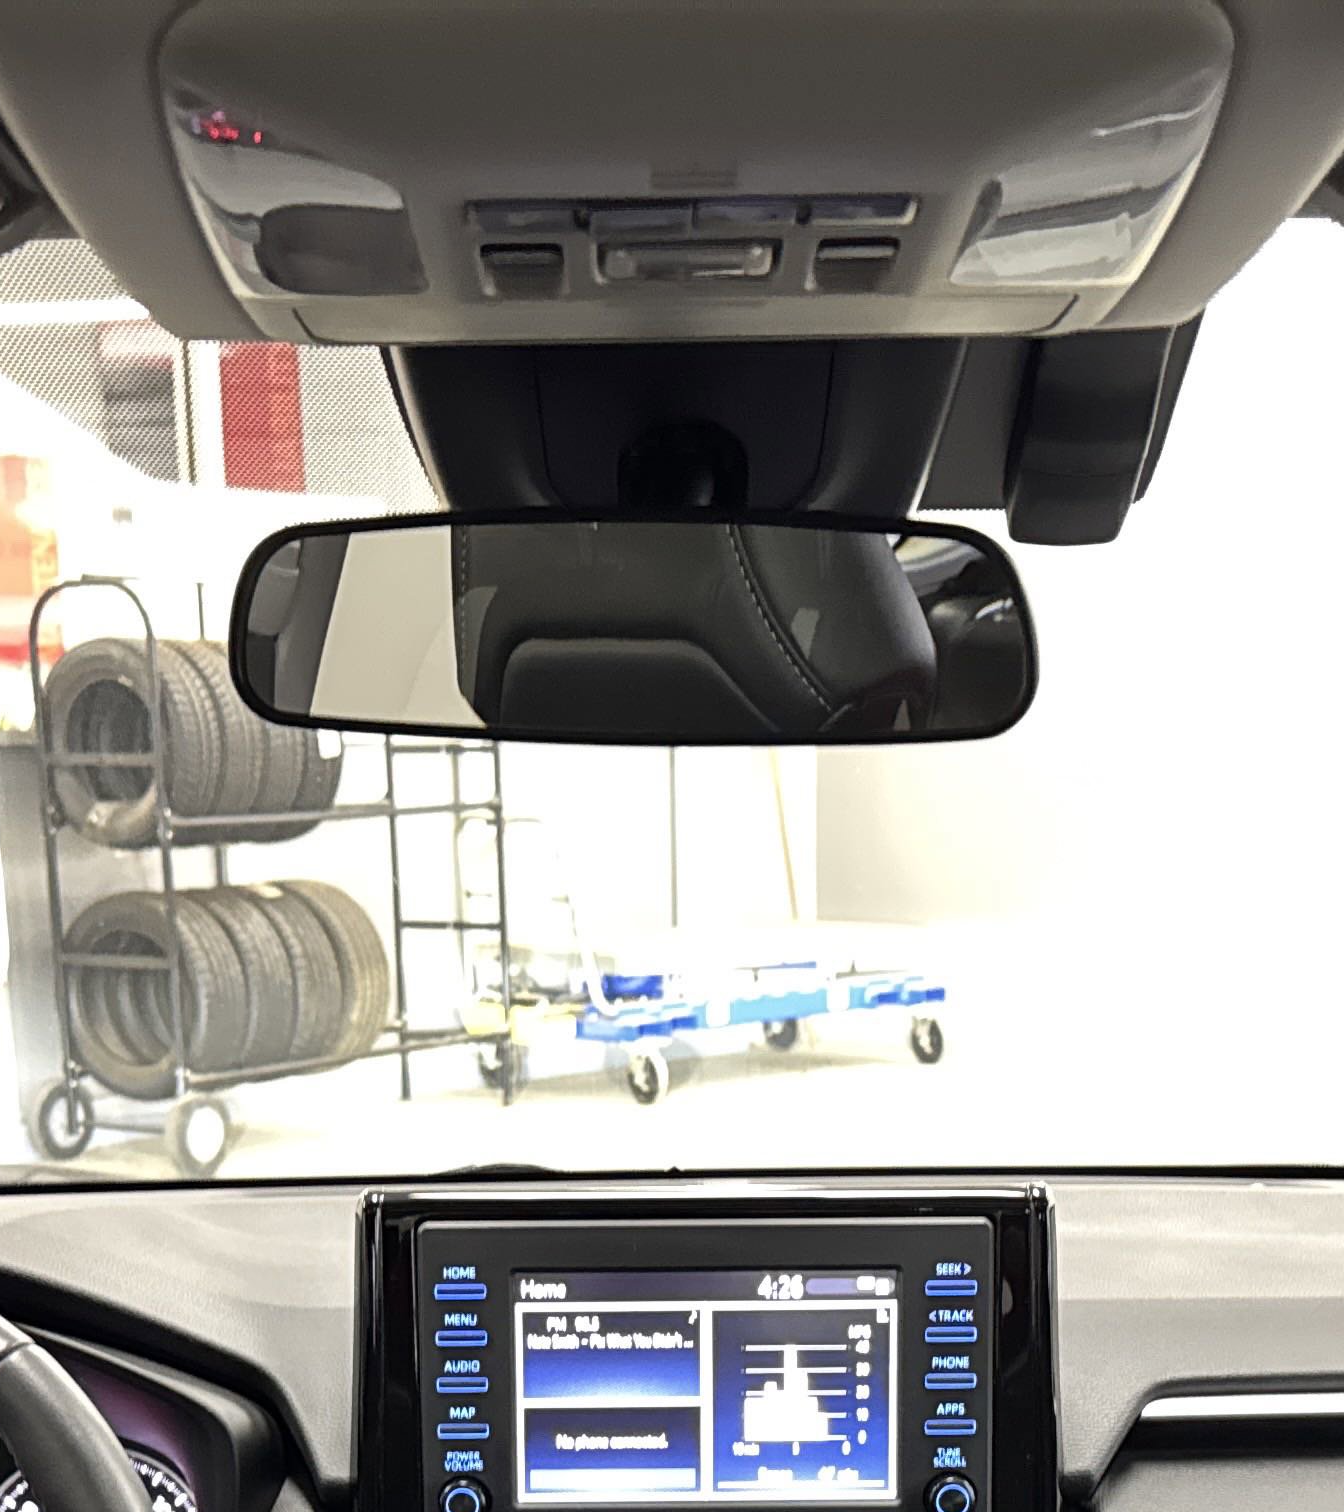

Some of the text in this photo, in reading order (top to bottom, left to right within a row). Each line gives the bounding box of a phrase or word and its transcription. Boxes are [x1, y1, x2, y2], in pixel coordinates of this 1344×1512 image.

[443, 1266, 476, 1280] HOME
[520, 1279, 566, 1300] Home
[757, 1274, 804, 1300] 4:26
[444, 1313, 477, 1326] MENU
[444, 1360, 480, 1373] AUDIO
[932, 1356, 970, 1370] PHONE
[449, 1406, 476, 1420] MAP
[936, 1403, 965, 1416] APPS
[446, 1451, 481, 1461] POWER
[445, 1460, 483, 1472] VOLUME
